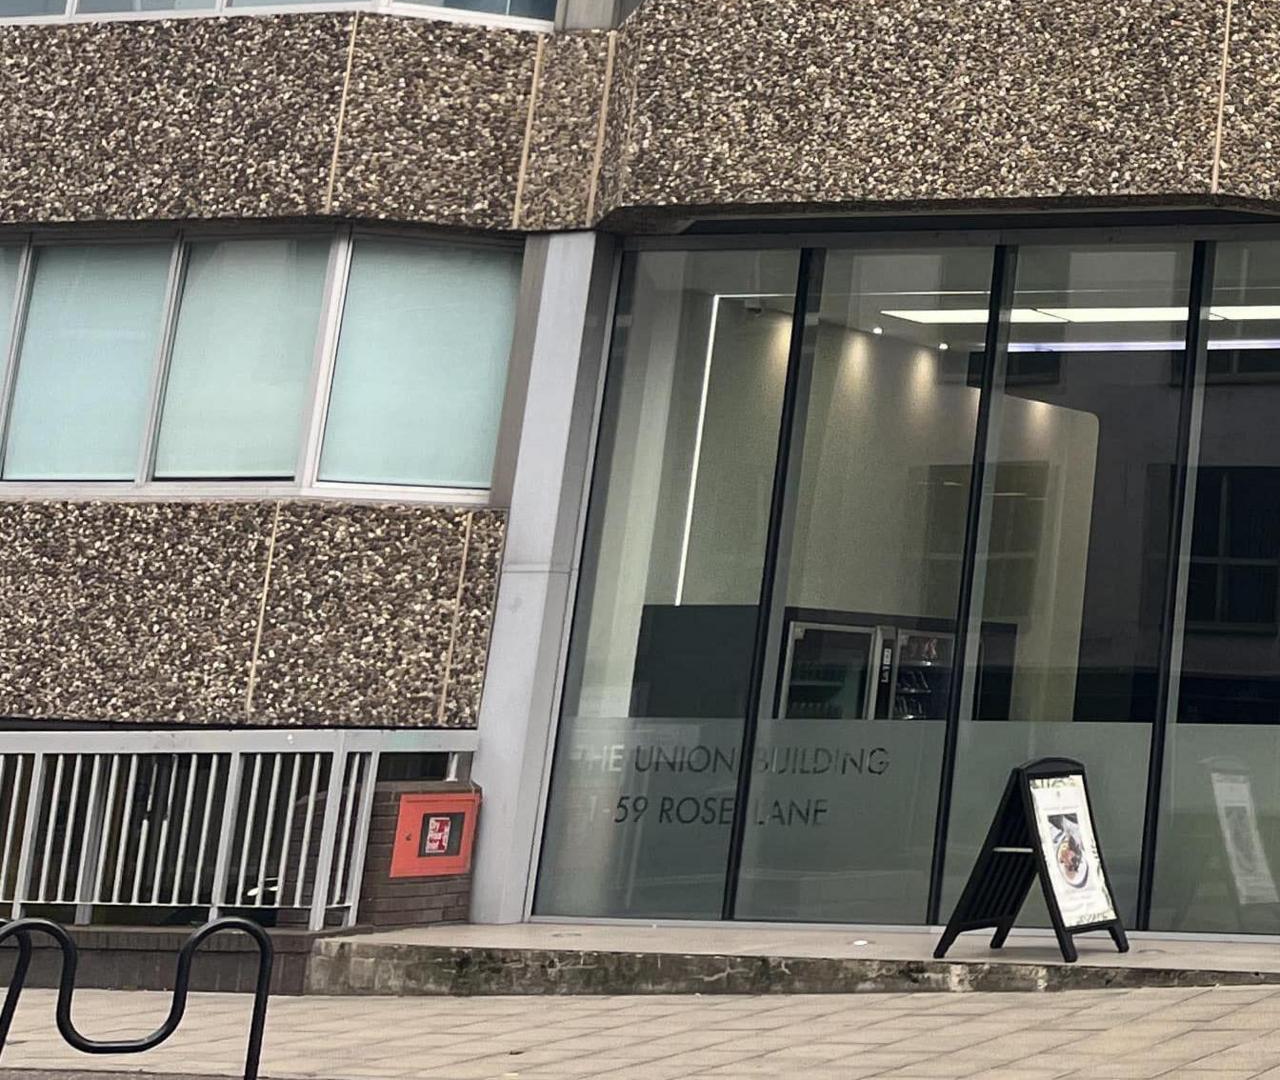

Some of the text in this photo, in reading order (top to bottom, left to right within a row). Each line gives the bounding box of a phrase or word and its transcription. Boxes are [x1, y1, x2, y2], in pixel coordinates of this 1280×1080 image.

[570, 744, 890, 775] THE UNION BUILDING
[659, 796, 735, 825] ROSE
[755, 797, 828, 826] LANE
